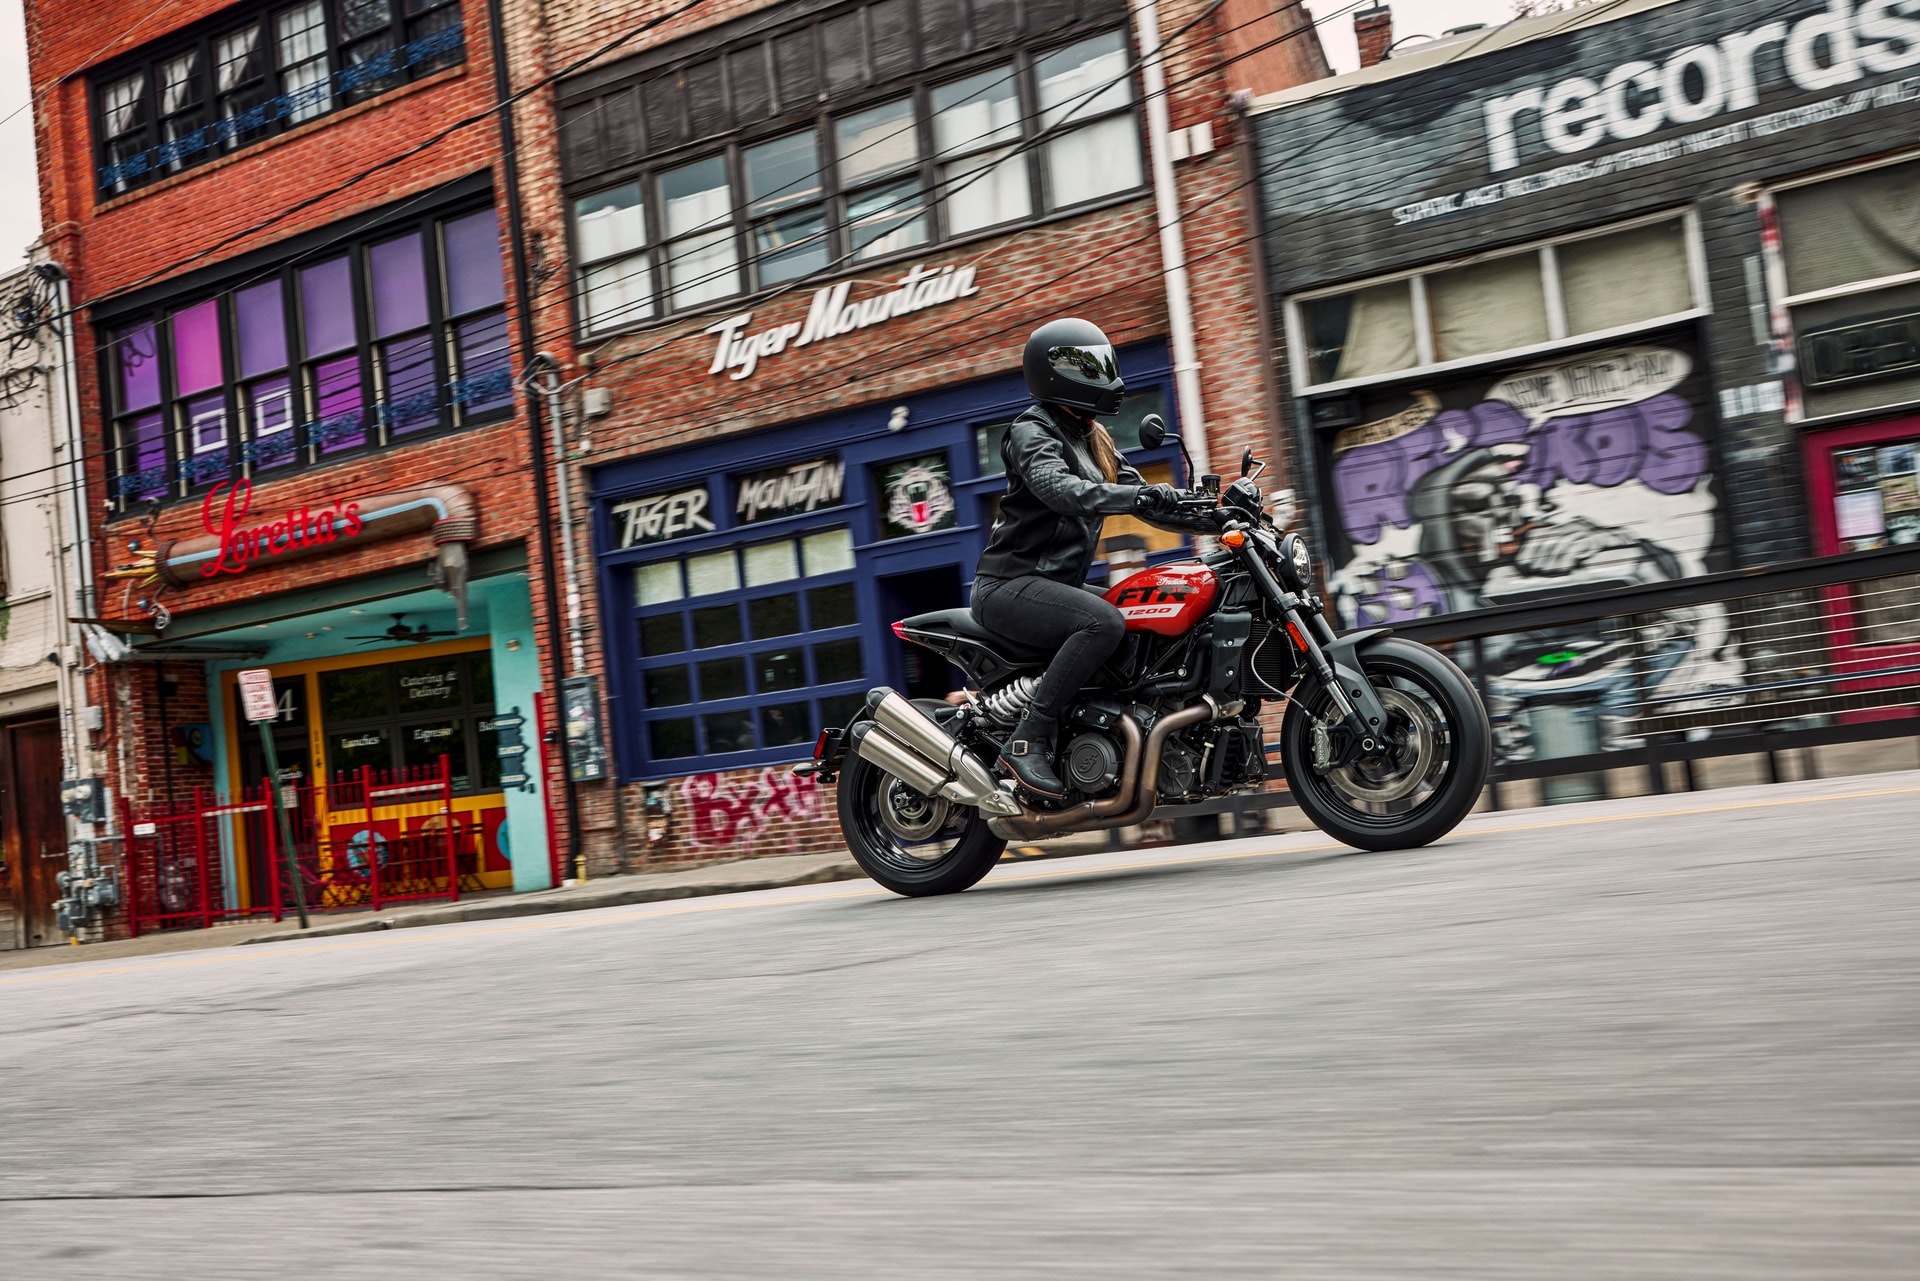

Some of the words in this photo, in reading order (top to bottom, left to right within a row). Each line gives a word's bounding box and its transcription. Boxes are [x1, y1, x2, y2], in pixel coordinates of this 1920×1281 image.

[1482, 0, 1920, 173] records
[704, 312, 802, 381] Tiger
[793, 263, 980, 348] Mountain
[201, 478, 363, 577] Loretta's
[612, 489, 717, 549] TIGER
[1115, 585, 1198, 606] FTR
[1127, 607, 1172, 616] 1200
[400, 672, 444, 687] Catering
[409, 684, 451, 699] Delivery
